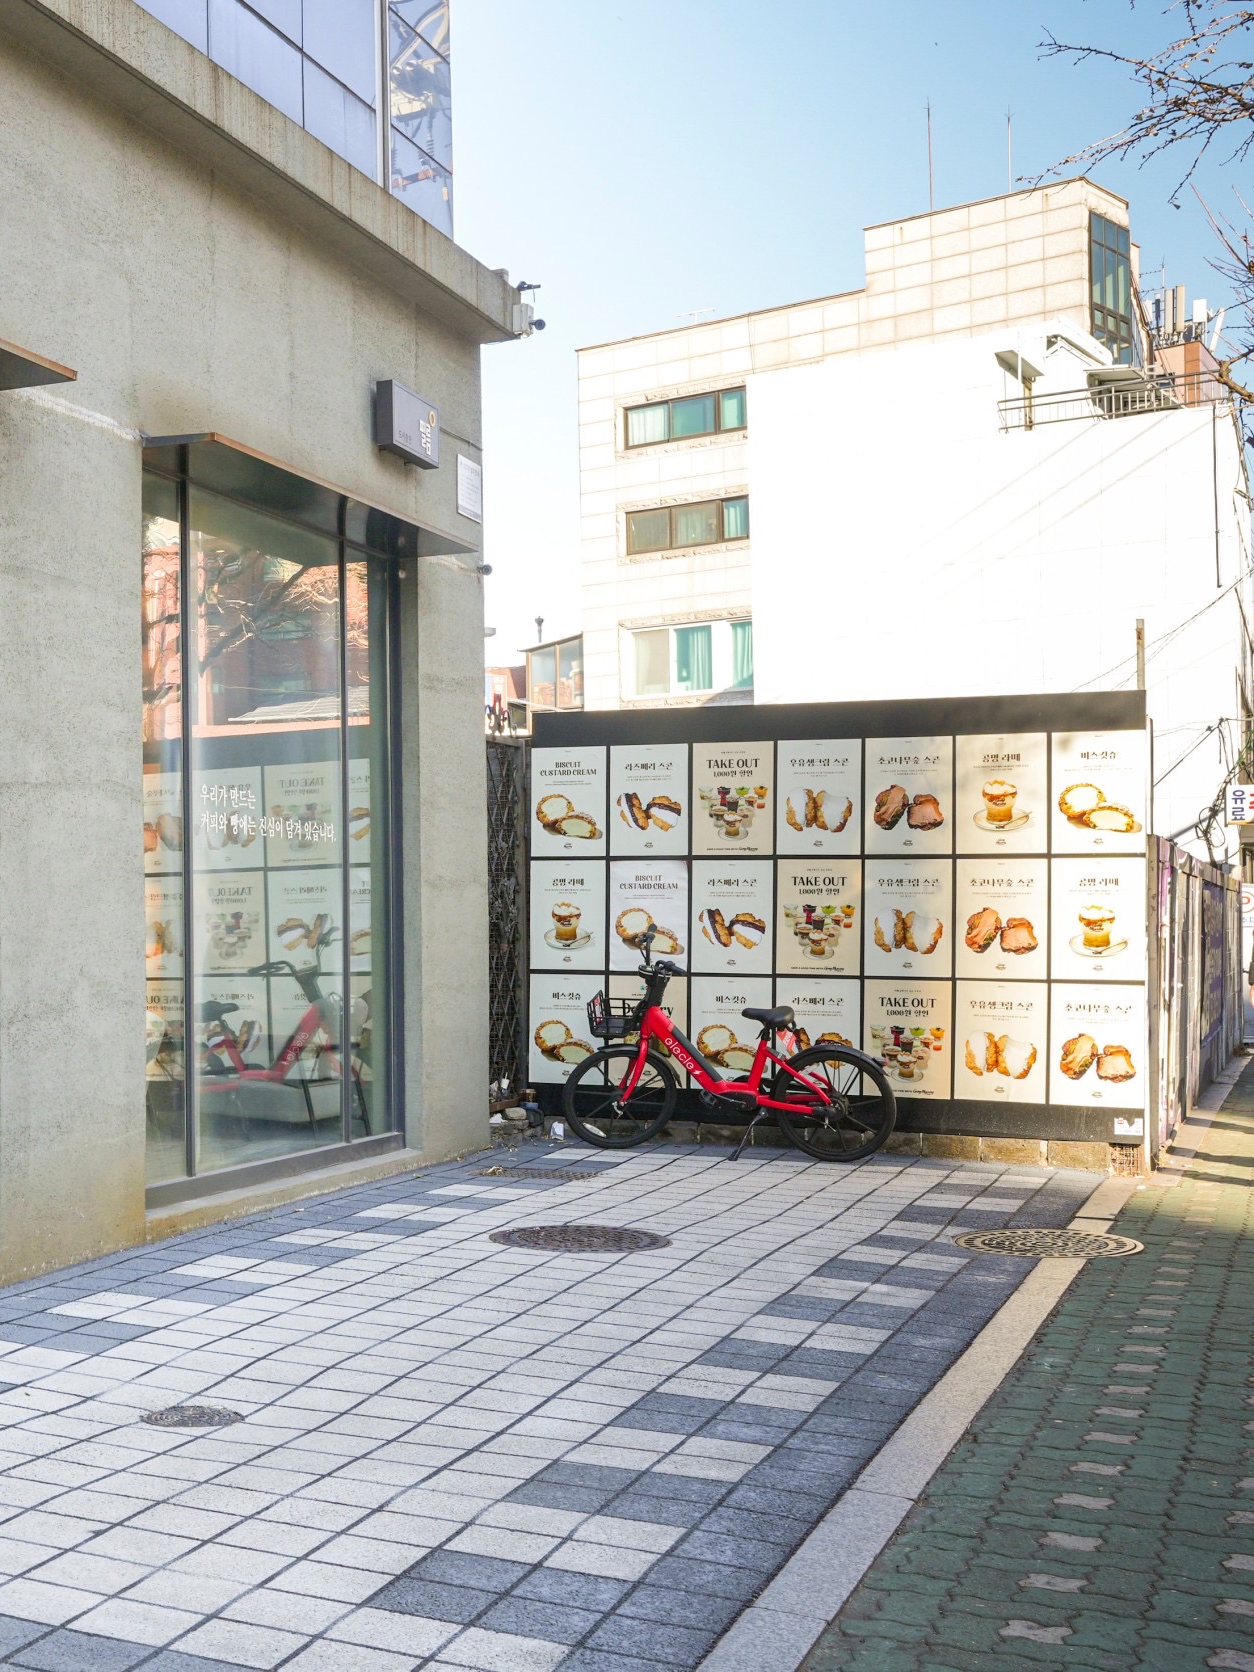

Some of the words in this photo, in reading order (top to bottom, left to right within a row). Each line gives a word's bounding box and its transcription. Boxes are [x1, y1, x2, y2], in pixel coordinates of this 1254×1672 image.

[555, 761, 581, 769] BISCUIT
[706, 758, 734, 769] TAKE
[736, 757, 760, 768] OUT
[540, 769, 571, 777] CUSTARD
[572, 768, 597, 776] CREAM
[200, 784, 228, 807] 우리가
[230, 787, 256, 809] 만드는
[1231, 789, 1247, 821] 유료
[201, 810, 228, 834] 커피와
[259, 816, 284, 839] 진심이
[304, 820, 337, 843] 있습니다.
[619, 882, 653, 890] CUSTARD
[653, 882, 678, 890] CREAM
[791, 876, 820, 887] TAKE
[822, 876, 847, 887] OUT
[878, 996, 909, 1008] TAKE
[911, 997, 937, 1008] OUT
[664, 1037, 694, 1070] elecle
